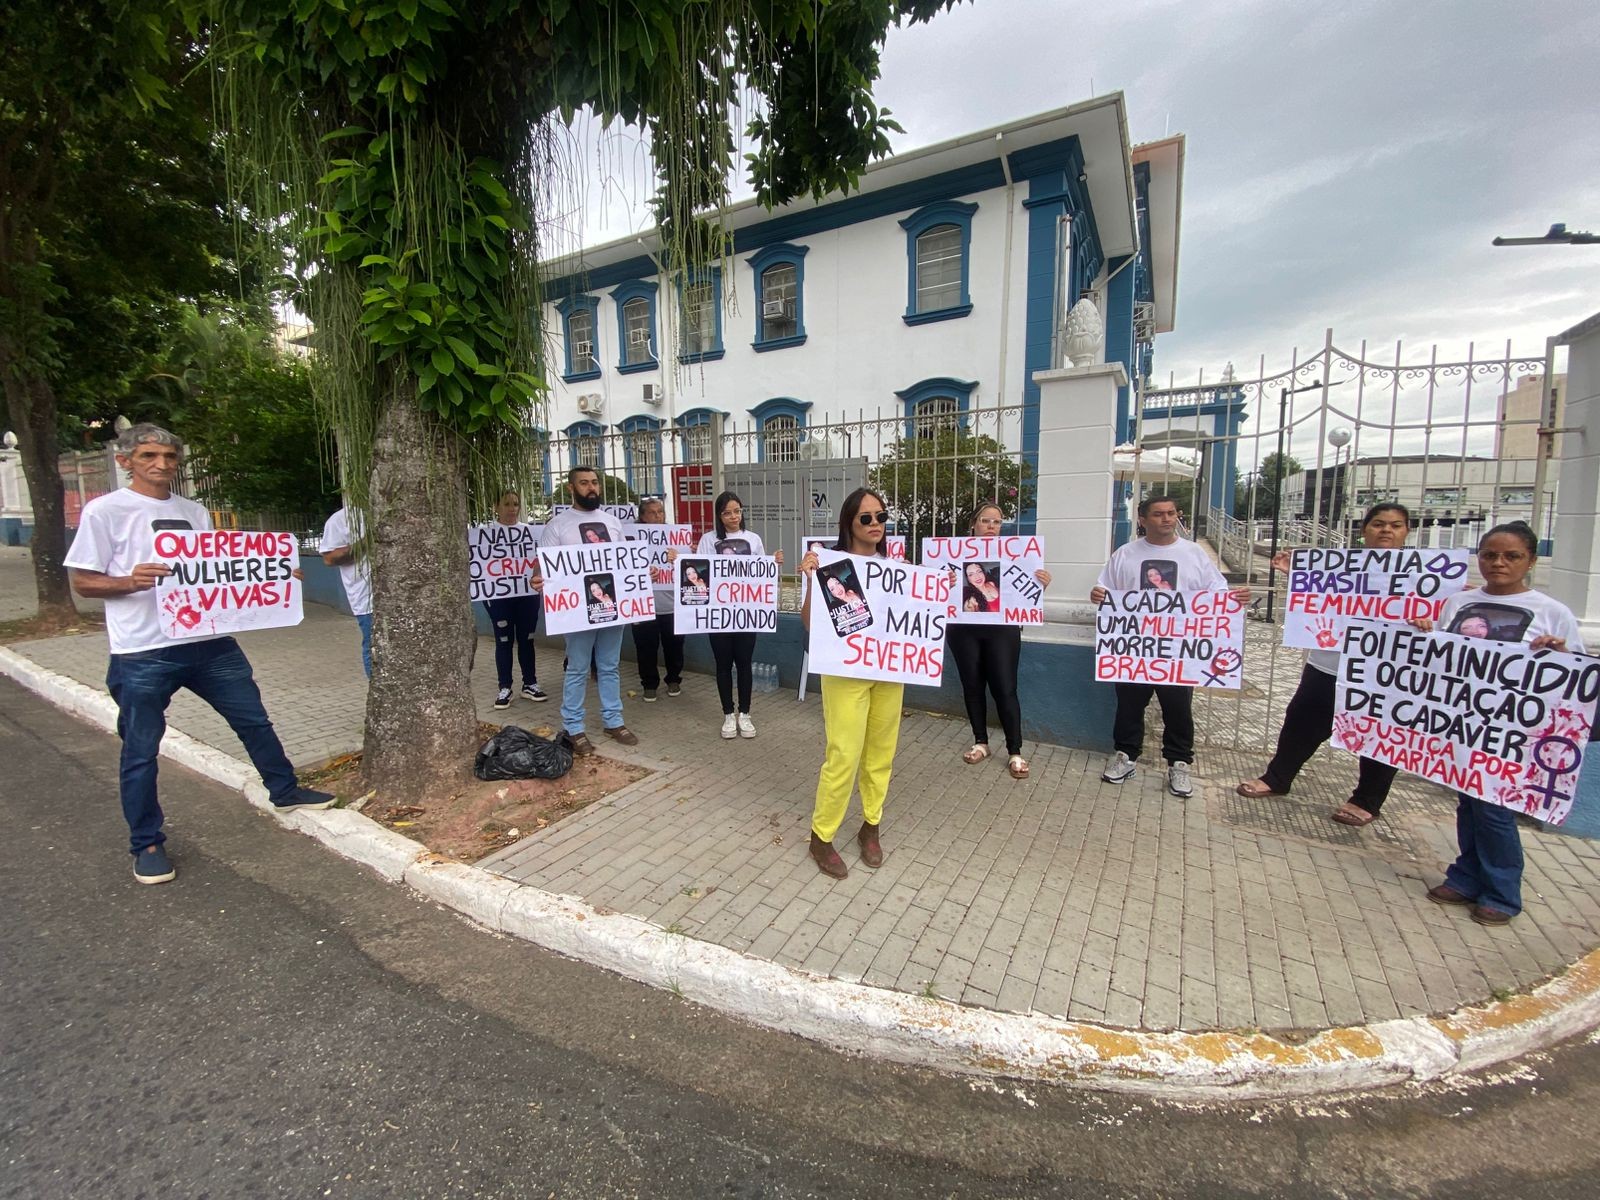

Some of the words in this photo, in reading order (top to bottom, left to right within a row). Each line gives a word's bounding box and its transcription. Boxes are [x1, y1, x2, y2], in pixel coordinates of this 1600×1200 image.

[154, 530, 292, 560] QUEREMOS
[479, 526, 533, 545] NADA
[638, 529, 668, 545] DIGA
[670, 528, 692, 546] NÃO
[927, 537, 1041, 561] JUSTIÇA
[157, 558, 292, 586] MULHERES
[470, 561, 482, 579] O
[542, 547, 650, 578] MULHERES
[651, 551, 668, 565] AO
[714, 557, 776, 578] FEMINICÍDIO
[1292, 549, 1422, 573] EPDEMIA
[1425, 553, 1468, 579] DO
[624, 575, 648, 592] SE
[716, 583, 774, 604] CRIME
[866, 562, 906, 595] POR
[911, 574, 949, 603] LEIS
[1003, 565, 1042, 606] FEITA
[1291, 570, 1380, 595] BRASIL
[1388, 569, 1410, 596] É
[1416, 573, 1441, 598] O
[545, 589, 579, 613] NÃO
[619, 596, 655, 618] CALE
[1005, 608, 1043, 623] MARI
[1098, 591, 1117, 612] A
[1122, 591, 1186, 614] CADA
[695, 605, 776, 630] HEDIONDO
[886, 606, 945, 641] MAIS
[1097, 615, 1140, 635] UMA
[1141, 616, 1230, 638] MULHER
[844, 634, 943, 678] SEVERAS
[1097, 635, 1172, 658] MORRE
[1180, 639, 1213, 660] NO
[1098, 656, 1199, 684] BRASIL
[1344, 624, 1386, 657] FOI
[1390, 630, 1600, 703] FEMINICÍDIO
[1347, 658, 1364, 684] E
[1377, 662, 1544, 728] OCULTAÇÃO
[1346, 688, 1385, 719] DE
[1392, 700, 1527, 763] CADÁVER
[1357, 716, 1455, 761] JUSTIÇA
[1469, 750, 1523, 786] POR
[1373, 743, 1483, 796] MARIANA
